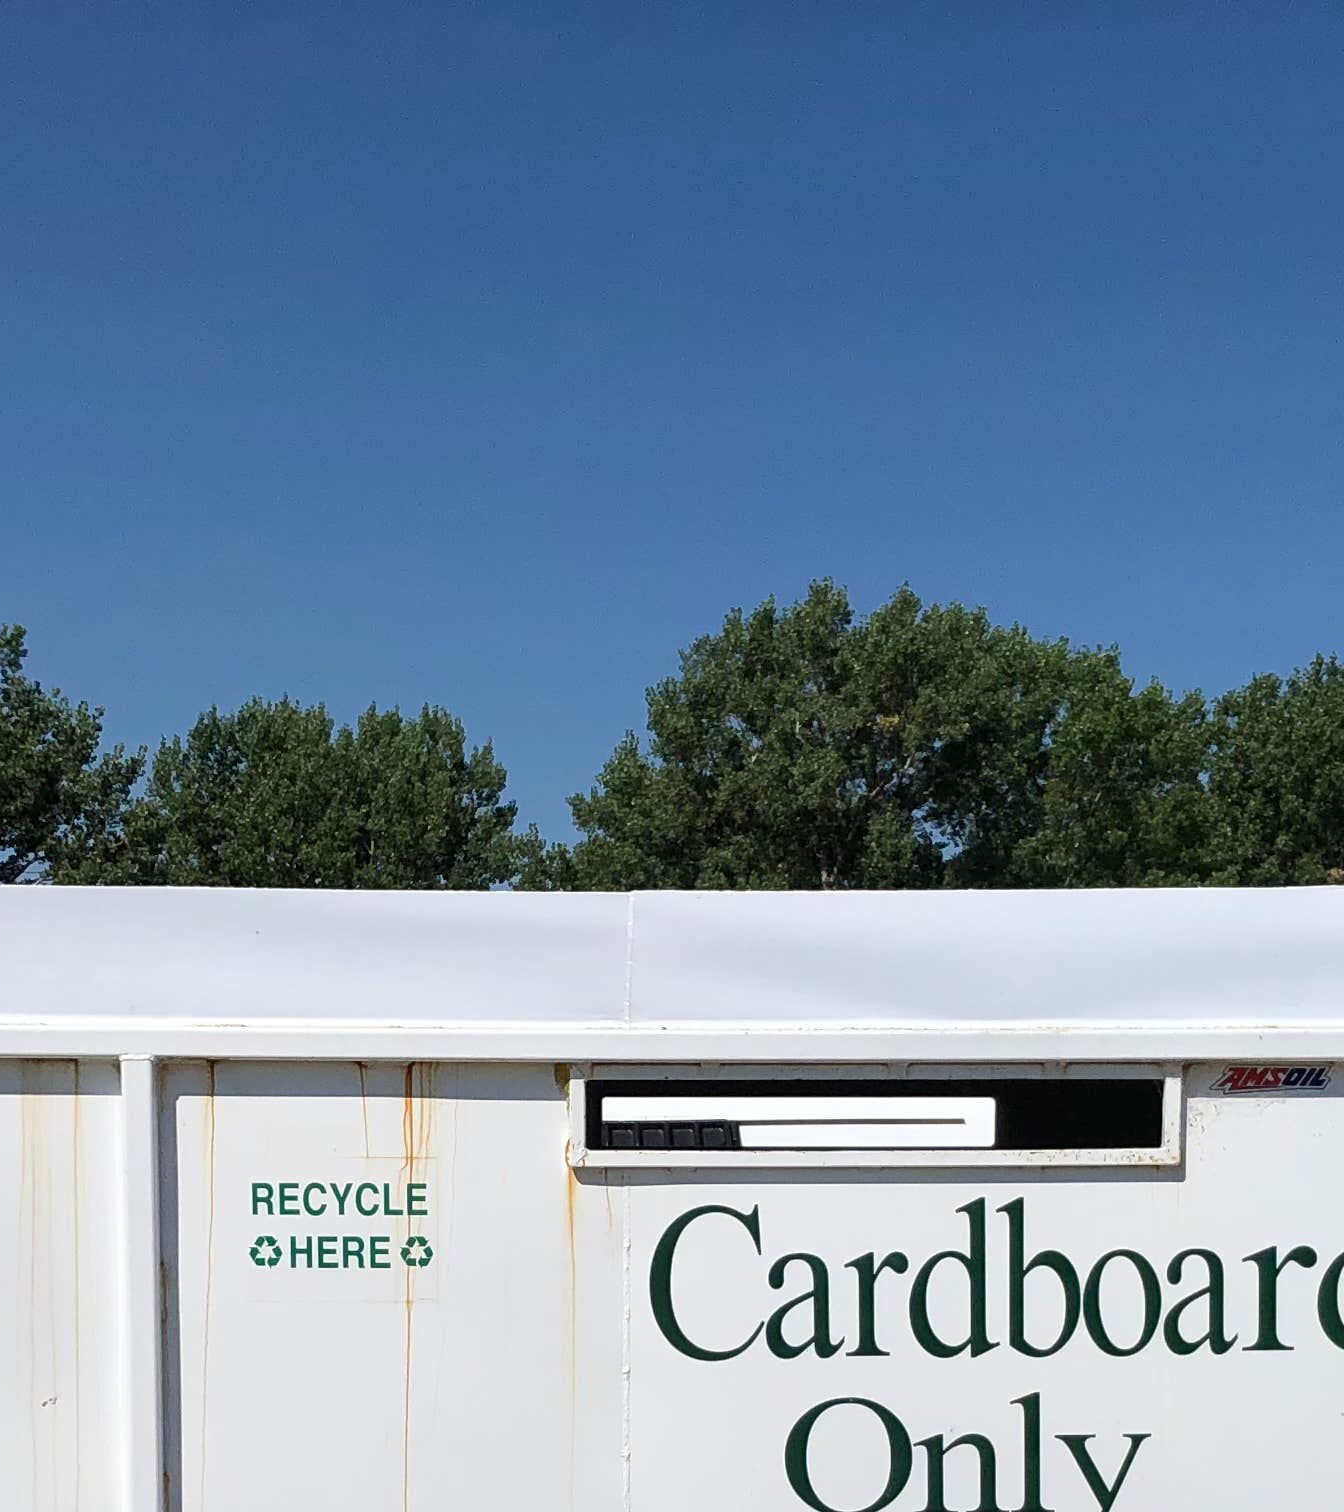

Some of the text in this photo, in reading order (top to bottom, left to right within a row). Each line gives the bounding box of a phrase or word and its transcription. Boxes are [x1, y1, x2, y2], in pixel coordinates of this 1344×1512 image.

[1216, 1066, 1328, 1090] AMSOIL
[251, 1182, 429, 1217] RECYCLE
[290, 1236, 392, 1269] HERE
